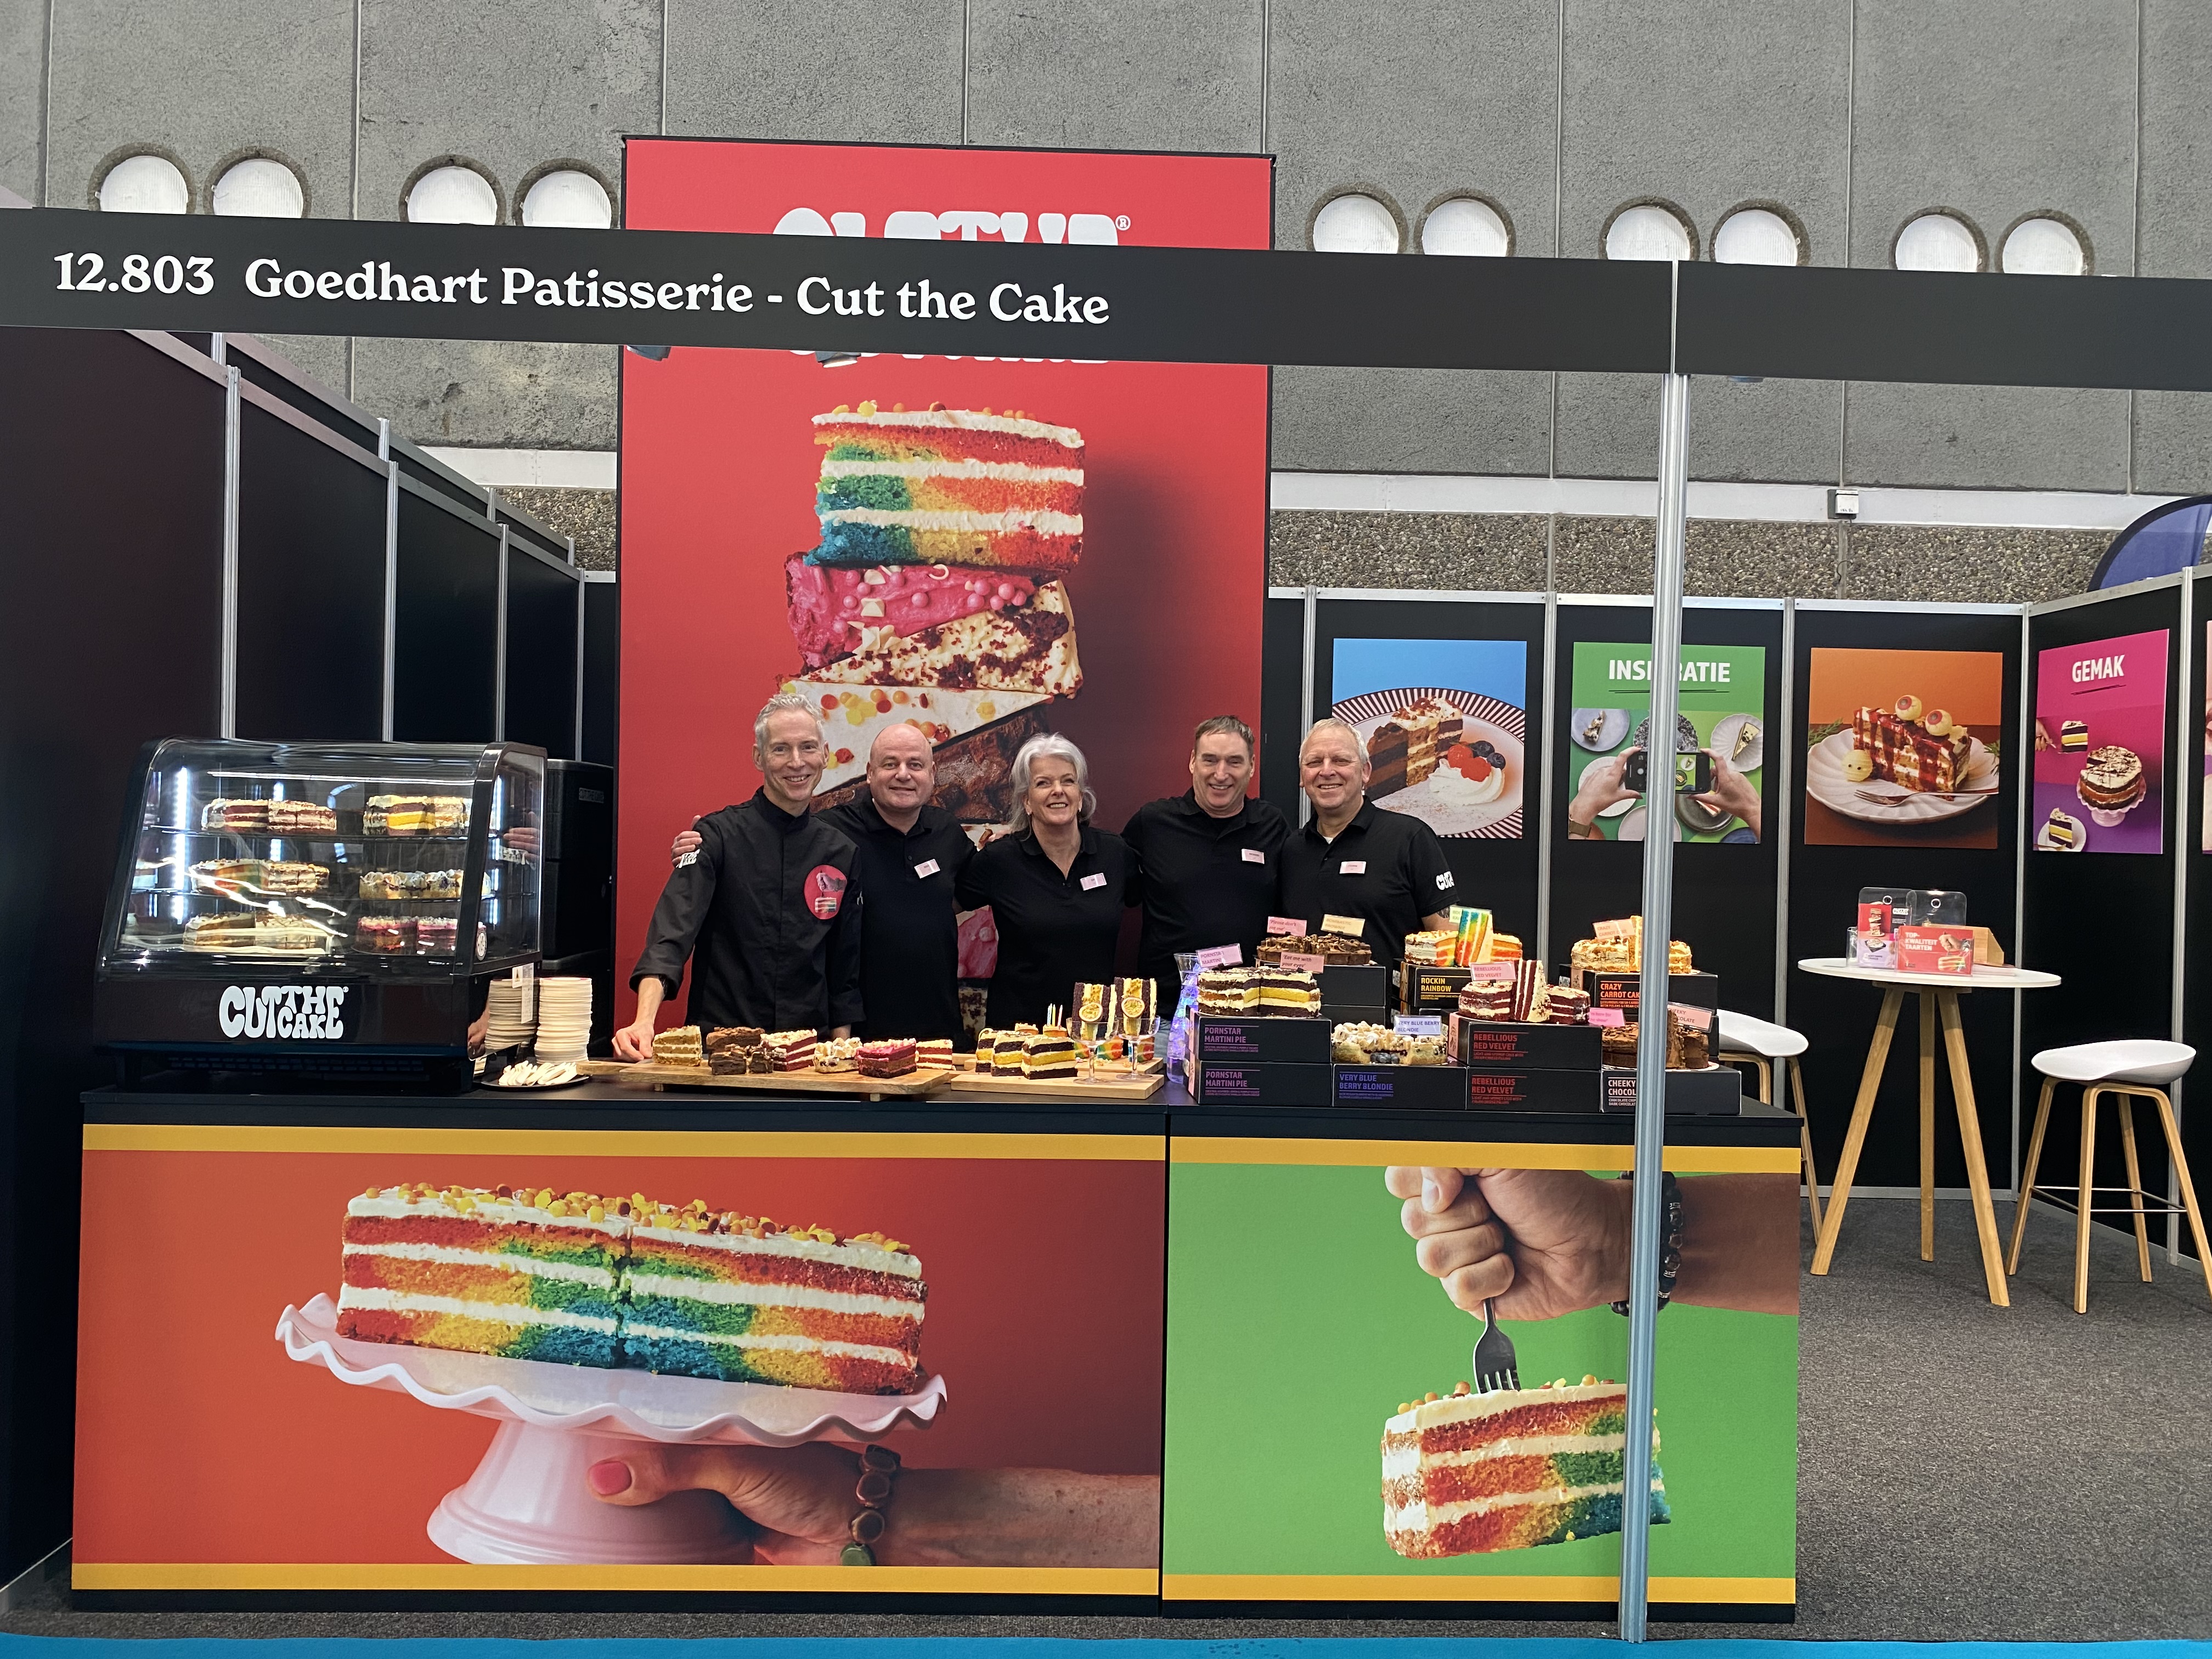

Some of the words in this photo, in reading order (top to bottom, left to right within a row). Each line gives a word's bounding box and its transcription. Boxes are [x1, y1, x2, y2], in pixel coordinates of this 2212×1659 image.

[54, 252, 214, 295] 12.803
[245, 258, 488, 304] Goedhart
[501, 268, 753, 312] Patisserie
[797, 276, 885, 317] Cut
[896, 279, 976, 320] the
[989, 283, 1109, 324] Cake
[1609, 660, 1730, 682] INSIATIE
[2072, 654, 2125, 682] GEMAK
[219, 985, 282, 1039] CUT
[280, 985, 344, 1026] THE
[277, 1005, 344, 1039] CAKE
[1474, 1034, 1517, 1042] REBELLIOUS
[1471, 1077, 1515, 1086] REBELLIOUS
